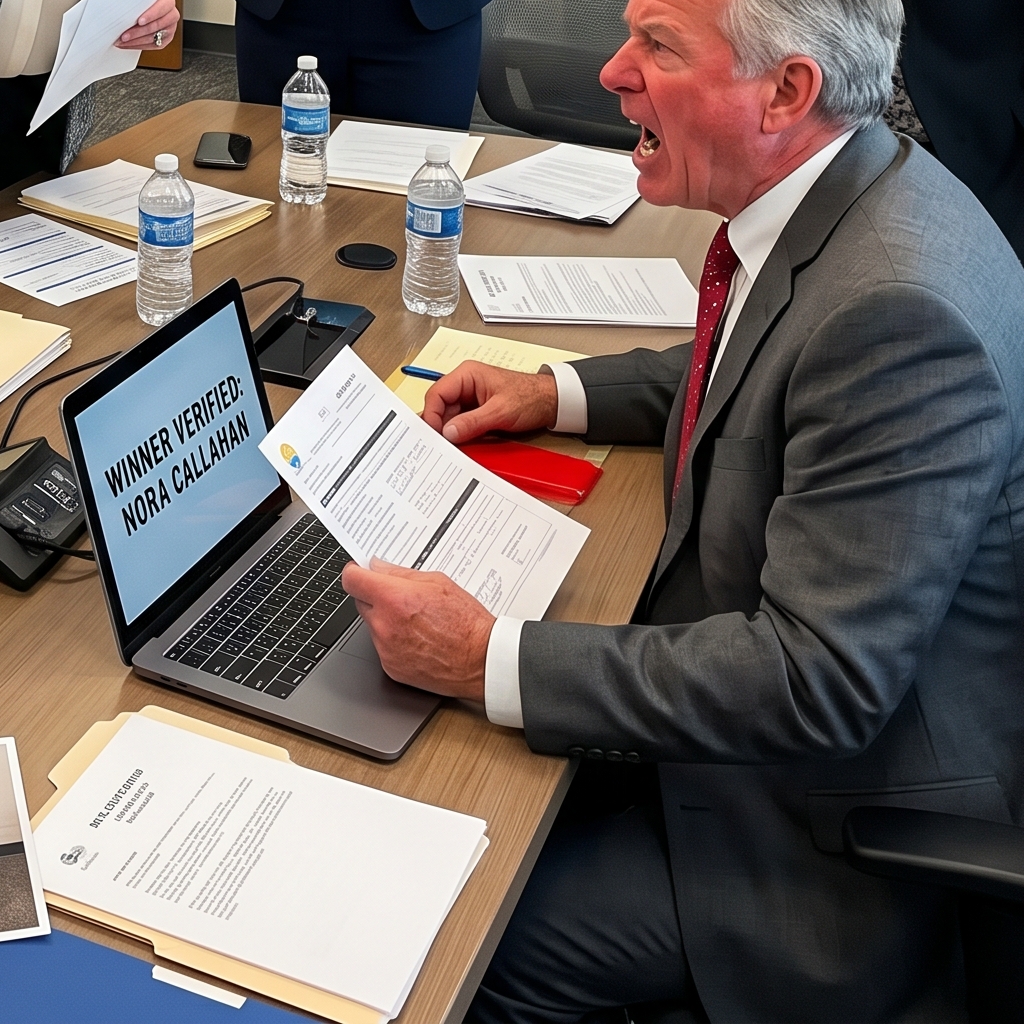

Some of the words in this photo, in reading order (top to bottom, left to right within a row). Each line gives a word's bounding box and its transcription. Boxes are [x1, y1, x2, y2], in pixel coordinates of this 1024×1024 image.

[104, 426, 174, 498] WINNER
[172, 375, 244, 445] VERIFIED:
[121, 478, 172, 537] NORA
[171, 410, 250, 494] CALLAHAN
